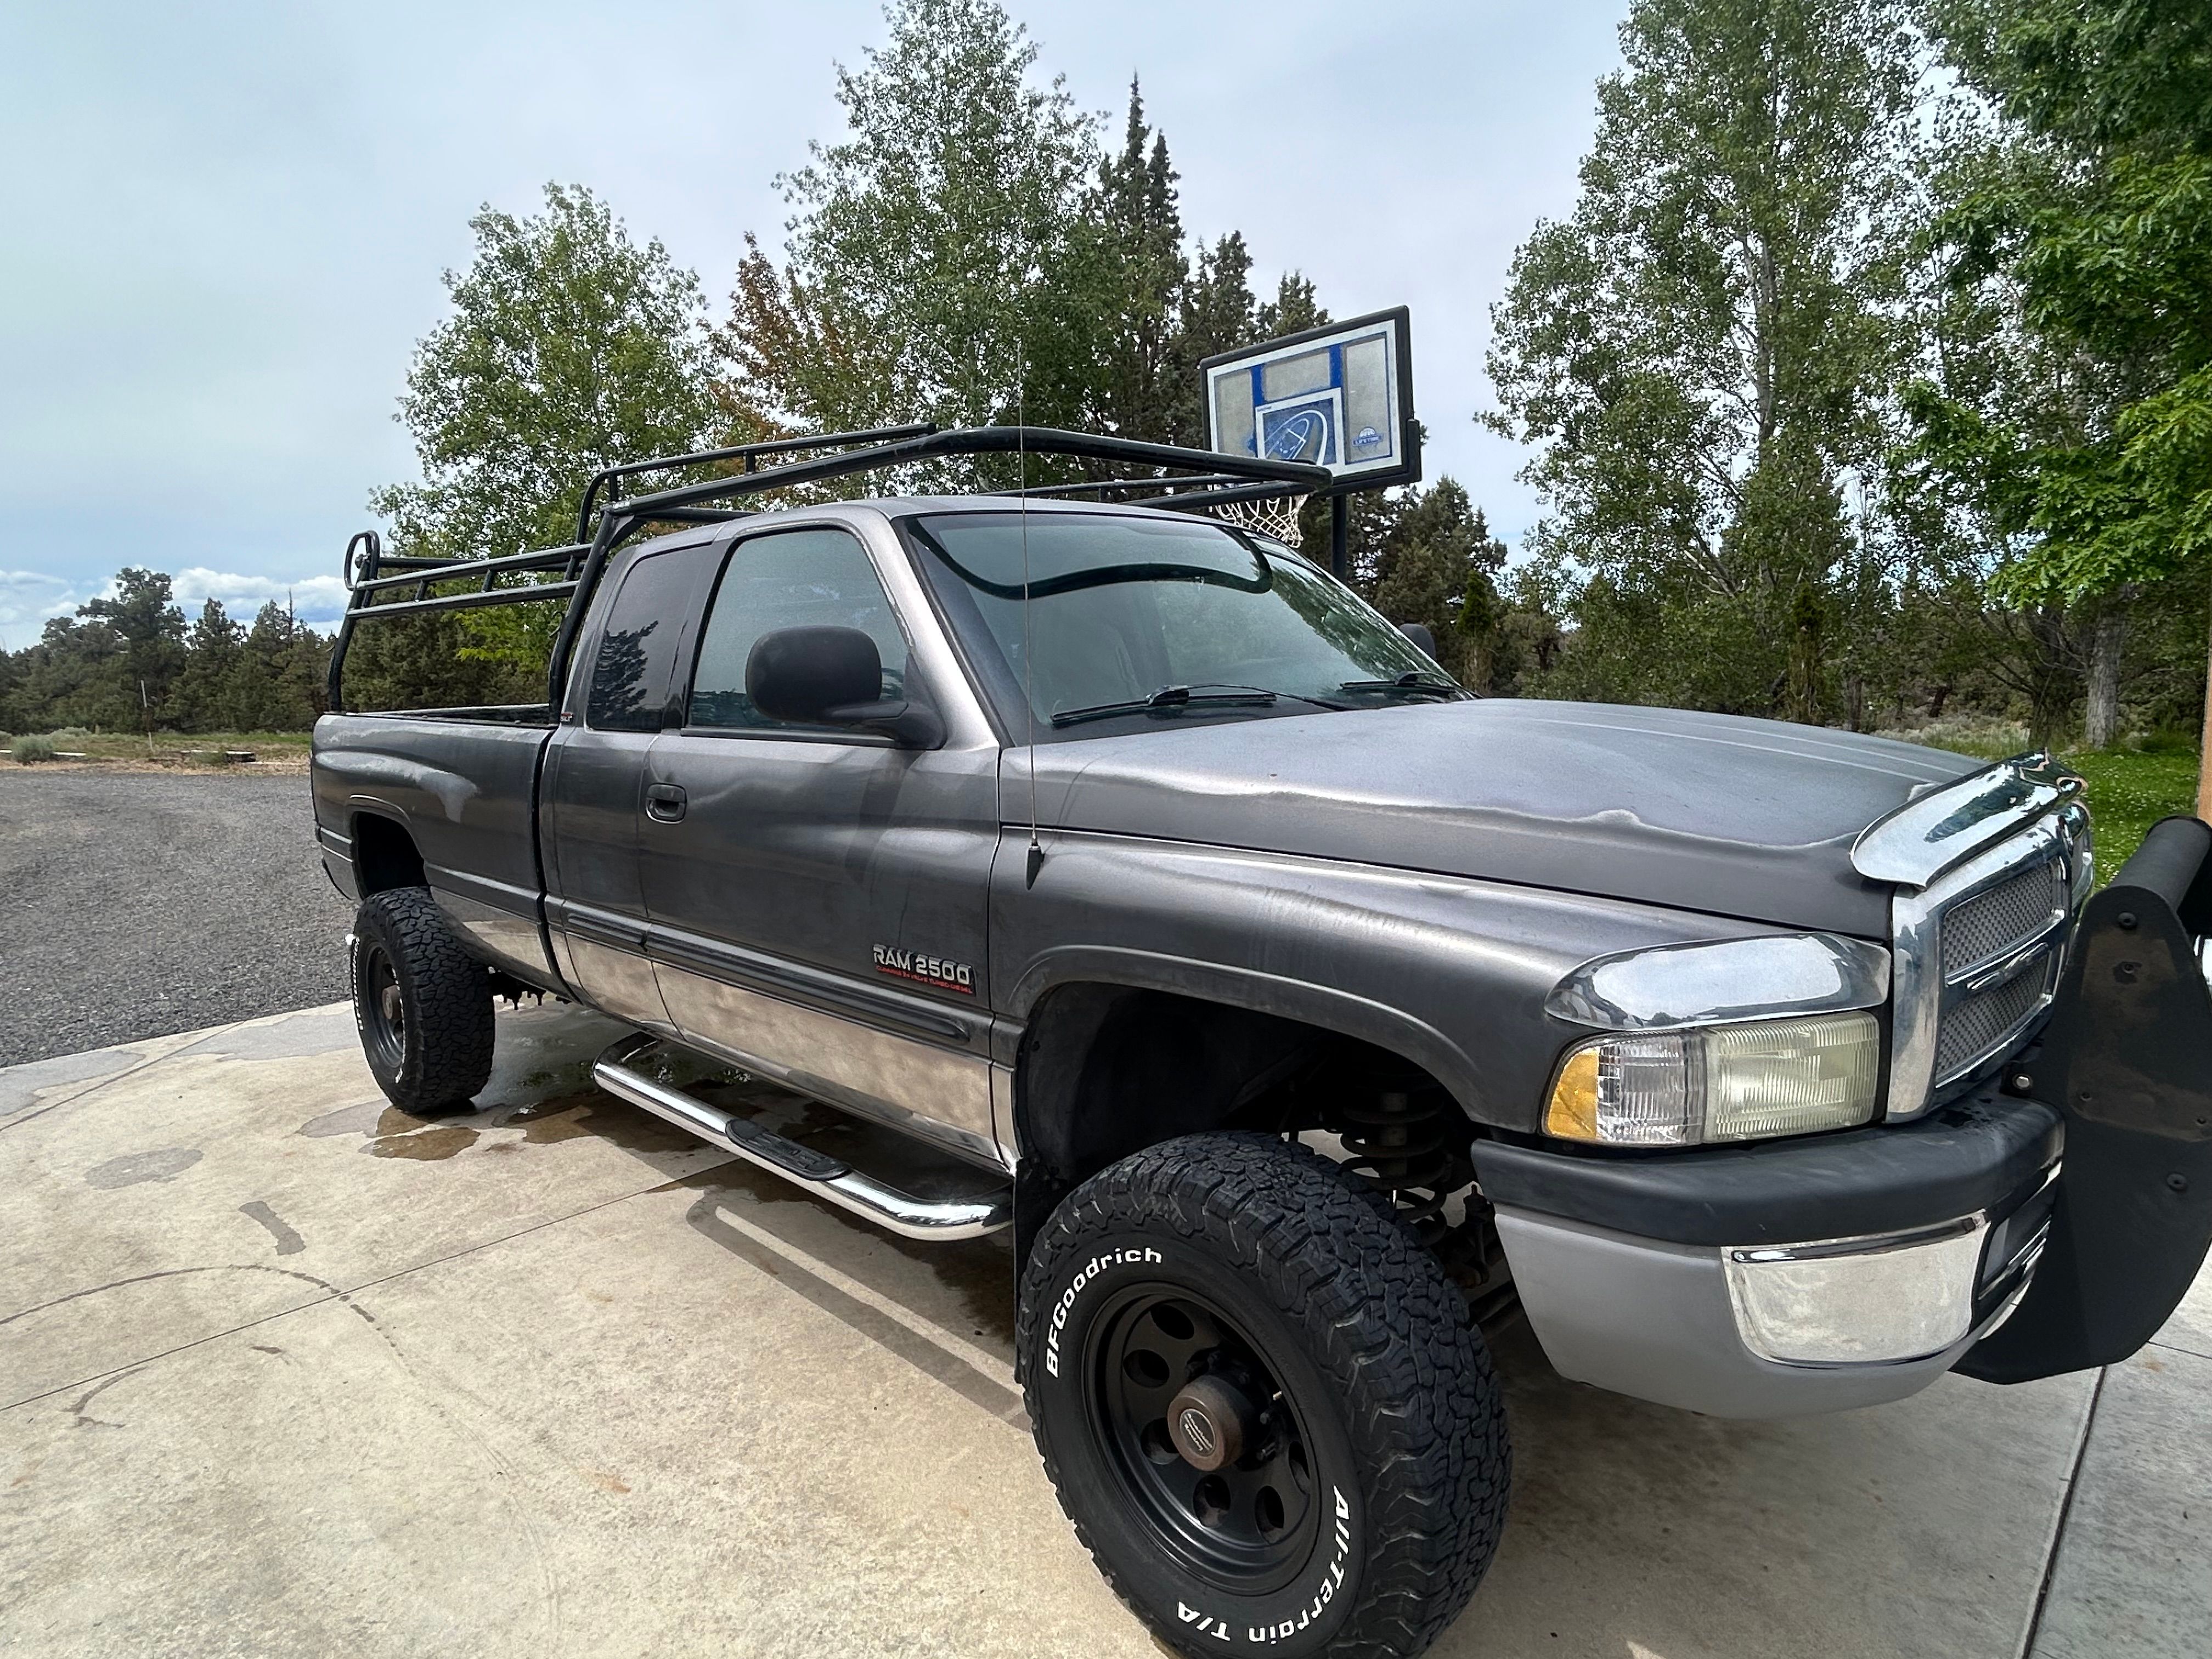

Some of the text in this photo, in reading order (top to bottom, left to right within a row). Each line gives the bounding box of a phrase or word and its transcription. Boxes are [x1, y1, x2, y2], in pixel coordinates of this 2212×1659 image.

[873, 944, 972, 985] RAM 2500
[1046, 1247, 1163, 1379] BFGoodrich
[1177, 1485, 1350, 1645] All-Terrain T/A
